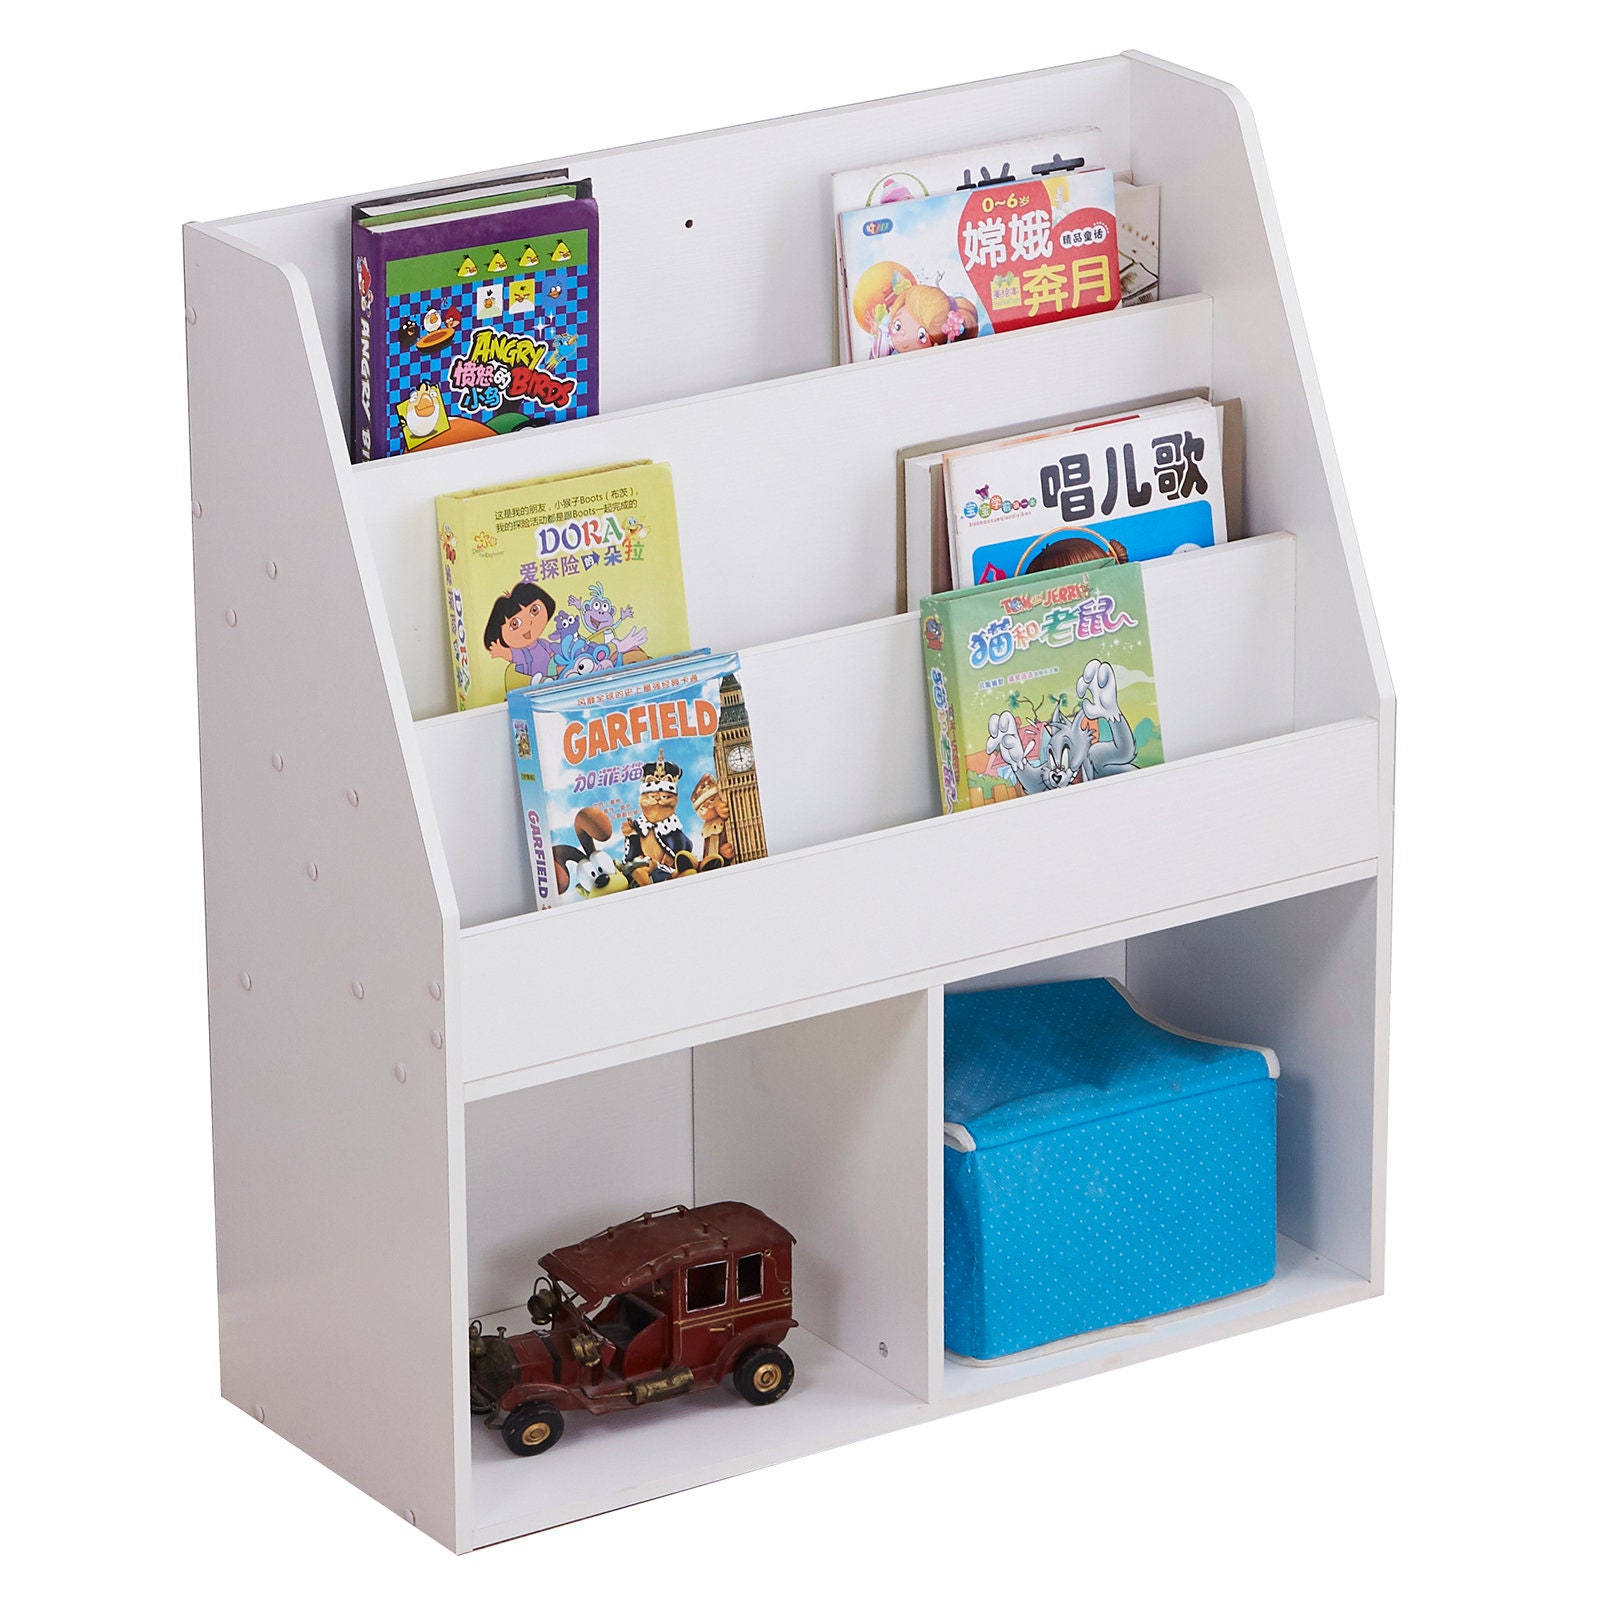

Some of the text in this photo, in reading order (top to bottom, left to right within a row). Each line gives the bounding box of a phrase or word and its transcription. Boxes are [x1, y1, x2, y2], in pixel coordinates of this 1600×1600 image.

[962, 209, 1053, 271] 嫦娥
[1062, 228, 1103, 246] 精品童话
[1023, 255, 1111, 317] 奔月
[361, 318, 371, 422] ANGRY
[470, 329, 546, 371] ANGRY
[453, 360, 512, 390] 愤怒的
[463, 386, 500, 410] 小鸟
[509, 365, 575, 407] BIRDS
[1040, 431, 1208, 523] 唱儿歌
[538, 516, 623, 556] DORA
[519, 537, 645, 584] 爱探险的朵拉
[970, 596, 1138, 668] 猫和老鼠
[563, 700, 718, 765] GARFIELD
[573, 762, 643, 793] 加菲猫
[528, 809, 549, 899] GARFIELD
